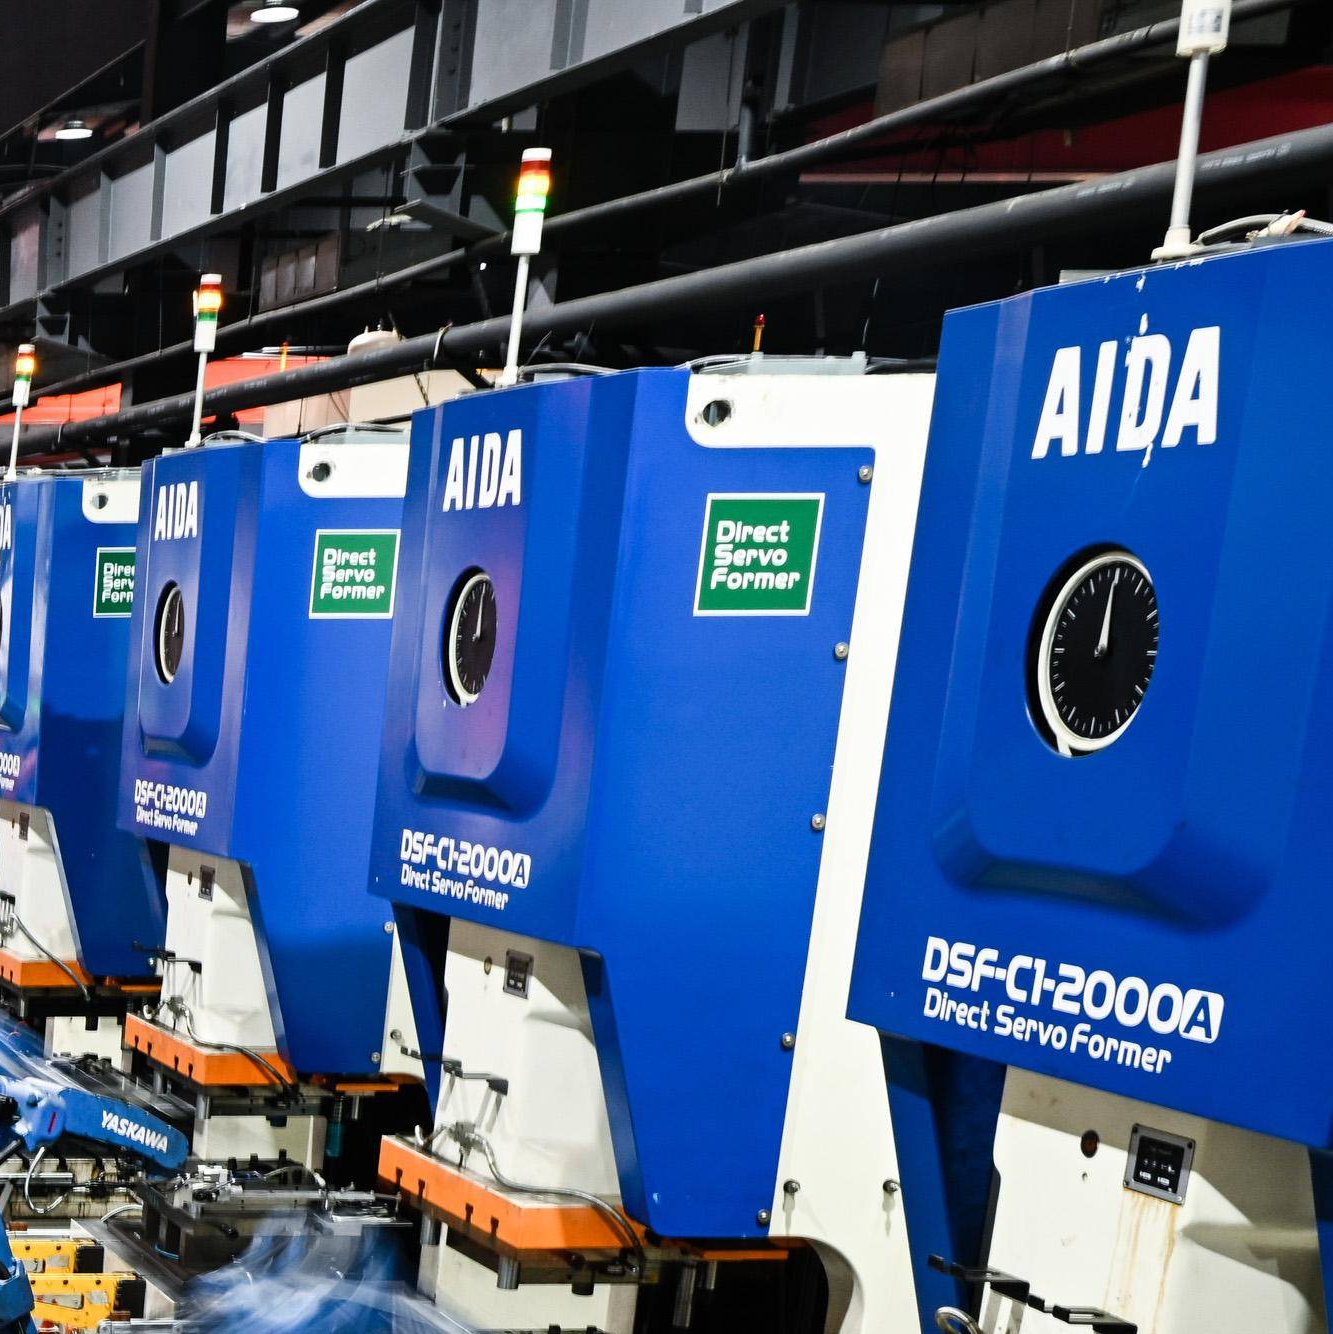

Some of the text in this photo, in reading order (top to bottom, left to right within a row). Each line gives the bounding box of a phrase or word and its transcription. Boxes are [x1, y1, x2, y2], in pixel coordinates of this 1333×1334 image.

[1031, 326, 1220, 460] AIDA
[443, 429, 522, 512] AIDA
[154, 480, 198, 541] AIDA
[716, 520, 790, 543] Direct
[322, 565, 375, 583] Servo
[323, 547, 376, 566] Direct
[713, 543, 788, 567] Servo
[102, 575, 134, 590] Serv
[320, 582, 385, 600] Former
[710, 567, 801, 590] Former
[134, 778, 207, 819] DSF-C1-2000A
[136, 805, 198, 836] Direct Servo Former
[400, 828, 531, 889] DSF-C1-2000A
[401, 863, 508, 911] Direct Servo Former
[922, 936, 1225, 1044] DSF-C1-2000A
[923, 987, 1172, 1074] Direct Servo Former
[101, 1110, 168, 1153] YASKAWA
